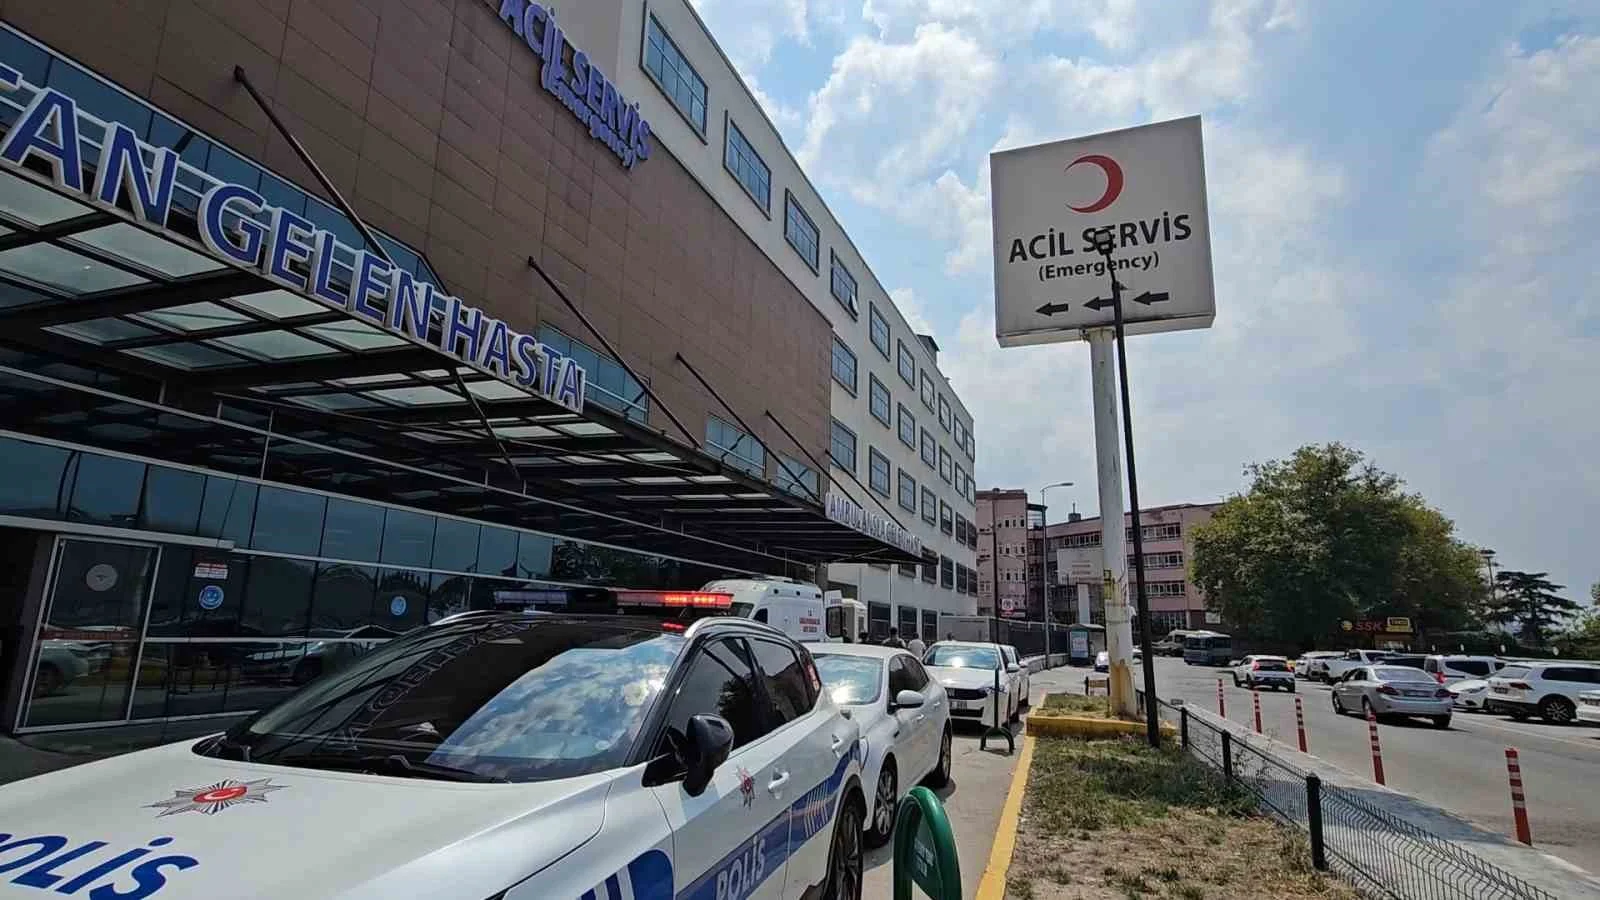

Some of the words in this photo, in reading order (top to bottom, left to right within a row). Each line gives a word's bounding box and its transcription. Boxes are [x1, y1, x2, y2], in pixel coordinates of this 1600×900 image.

[571, 48, 653, 161] SERVİS
[0, 62, 179, 228] AN
[197, 184, 434, 345] GELEN
[442, 296, 583, 411] HASTA
[1008, 227, 1075, 264] ACİL
[1082, 211, 1192, 253] SERVİS
[1038, 251, 1160, 282] (Emergency)
[0, 832, 200, 900] OLİS
